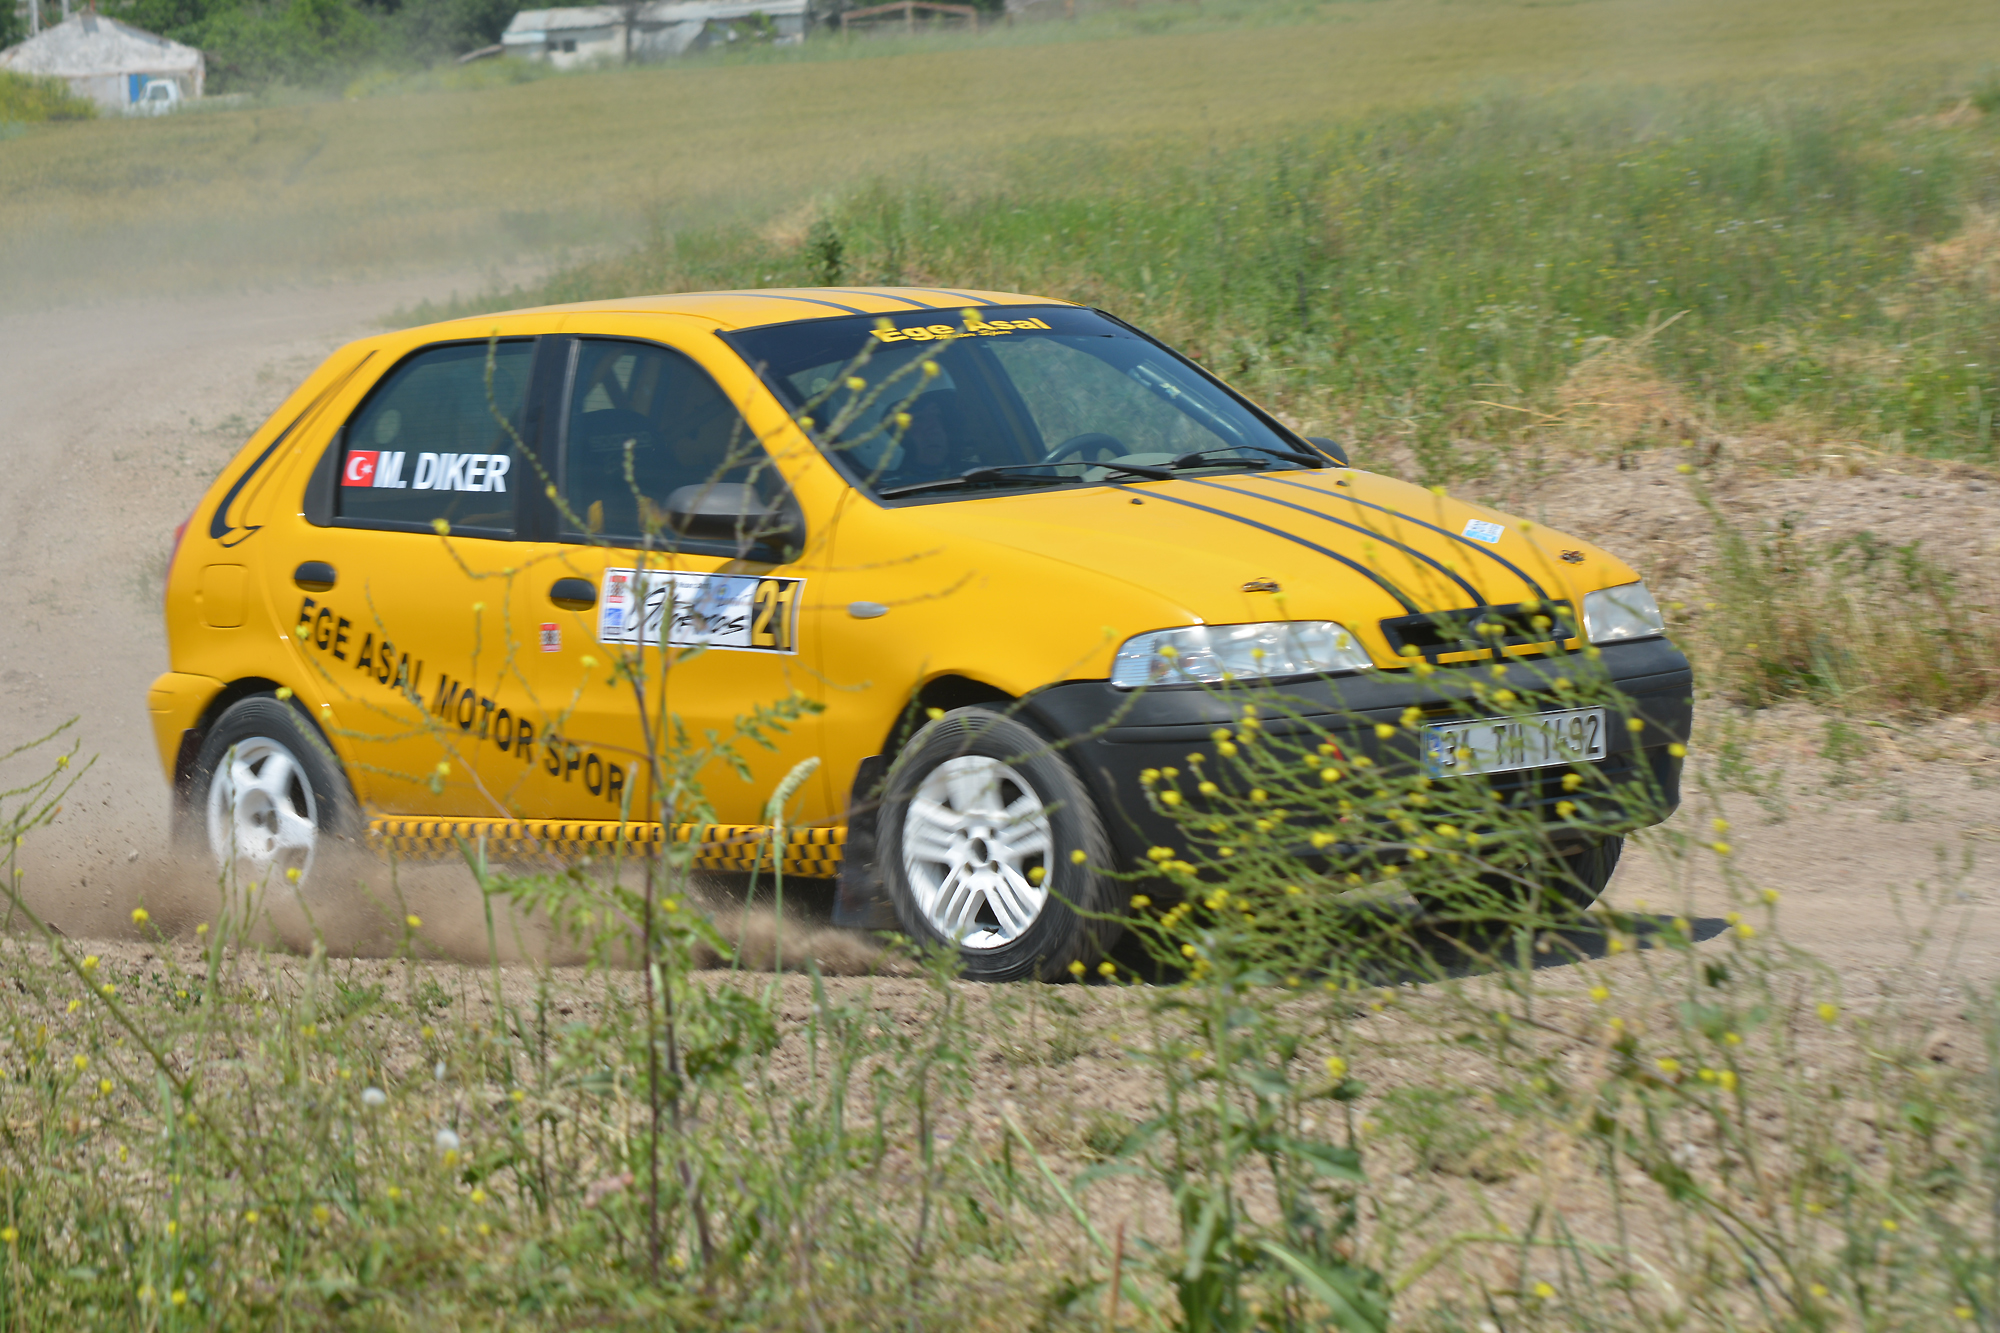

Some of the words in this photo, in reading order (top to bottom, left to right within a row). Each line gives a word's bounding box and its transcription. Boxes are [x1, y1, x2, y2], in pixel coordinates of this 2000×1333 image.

[869, 324, 956, 343] Ege
[963, 317, 1053, 332] Asal
[373, 451, 407, 488] M.
[412, 452, 511, 493] DIKER
[751, 579, 800, 649] 21
[297, 597, 352, 661] EGE
[355, 632, 423, 702] ASAL
[432, 673, 534, 764] MOTOR
[543, 733, 627, 807] SPOR
